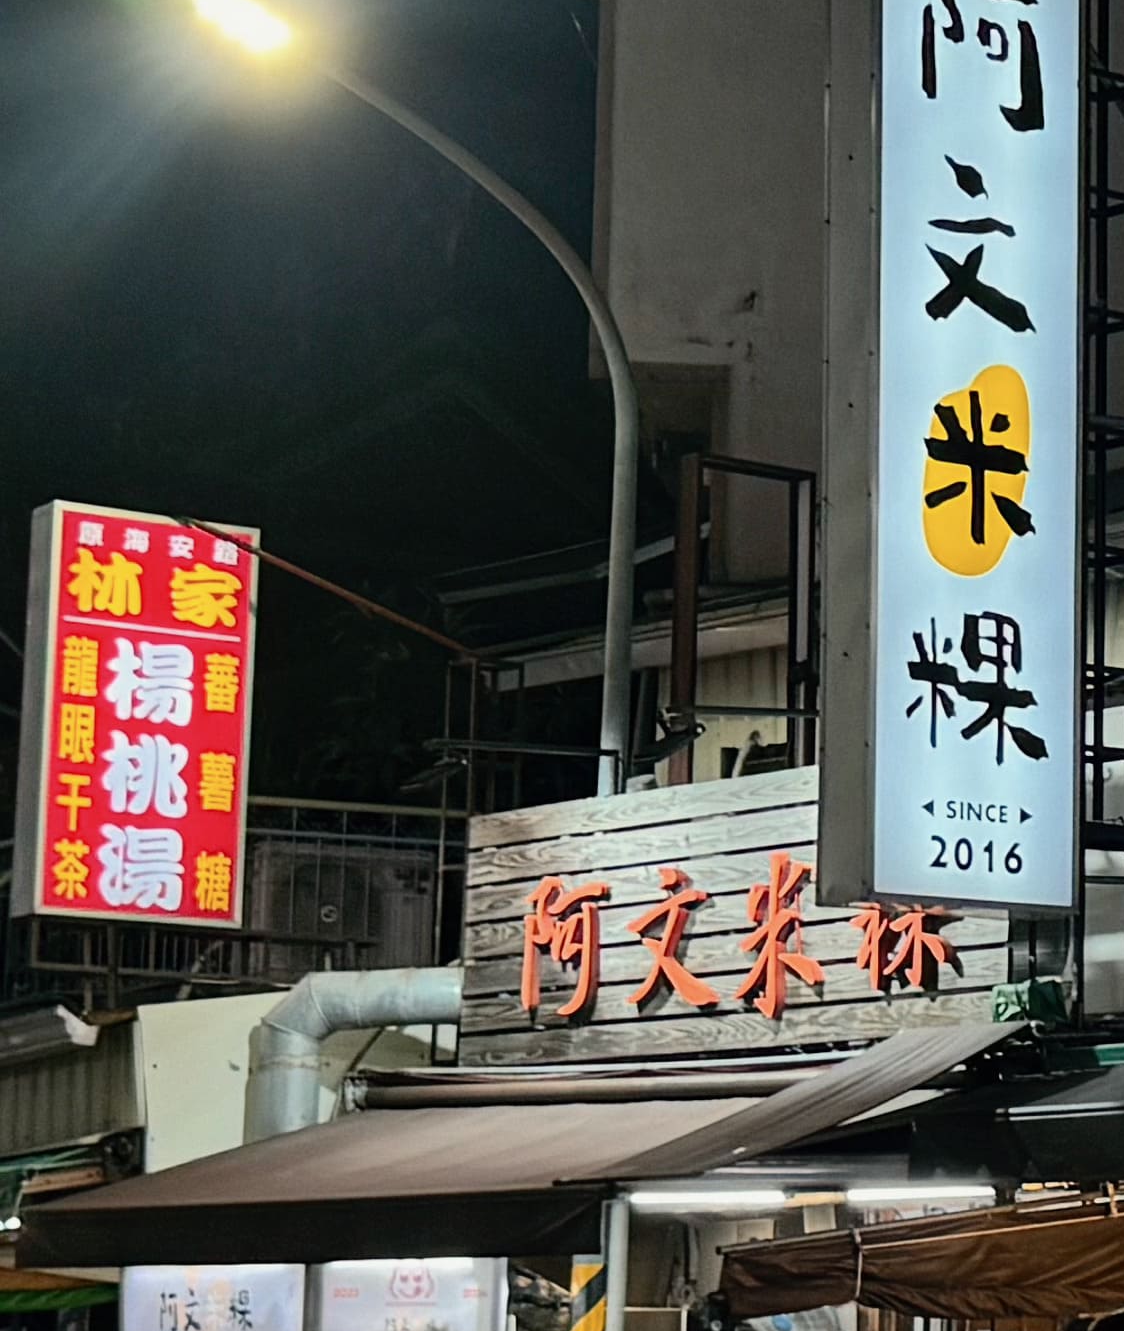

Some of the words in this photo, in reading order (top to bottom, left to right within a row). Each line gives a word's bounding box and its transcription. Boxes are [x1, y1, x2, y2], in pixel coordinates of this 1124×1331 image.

[68, 547, 243, 628] 林家
[52, 635, 98, 900] 龍眼干茶
[98, 637, 194, 912] 楊桃湯
[194, 652, 240, 912] 蕃薯糖
[946, 800, 1009, 824] SINCE
[929, 835, 1023, 875] 2016
